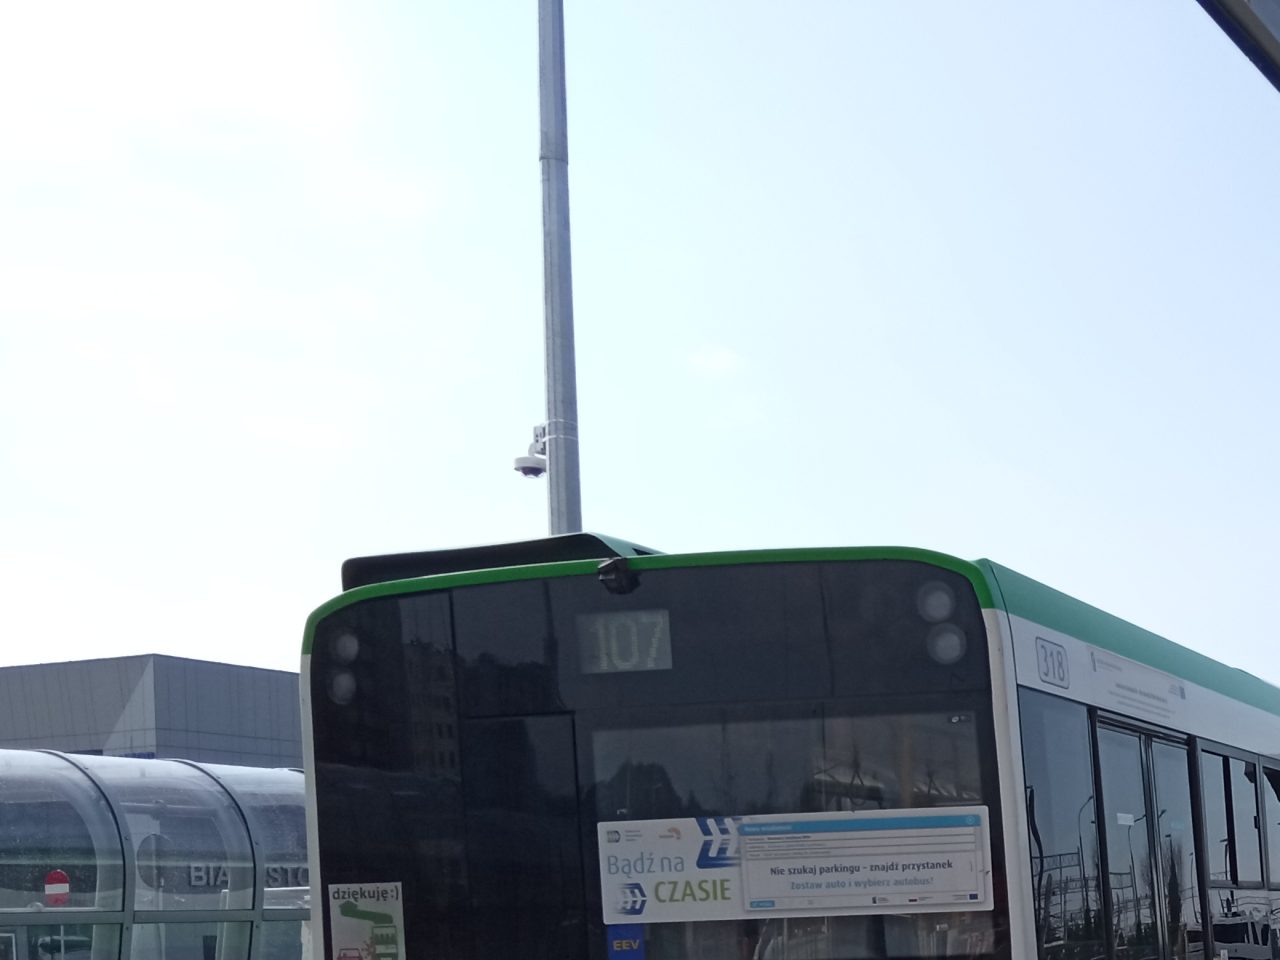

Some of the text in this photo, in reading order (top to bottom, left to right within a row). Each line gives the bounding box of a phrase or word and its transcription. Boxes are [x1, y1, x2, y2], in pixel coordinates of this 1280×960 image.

[590, 614, 665, 671] 107
[1040, 643, 1066, 682] 318
[607, 851, 685, 879] Bądź na
[770, 866, 786, 876] Nie
[788, 864, 817, 876] szukaj
[819, 863, 861, 876] parkingu
[901, 858, 953, 873] przystanek
[654, 878, 732, 904] CZASIE
[825, 879, 846, 889] auto
[612, 939, 640, 951] EEV
